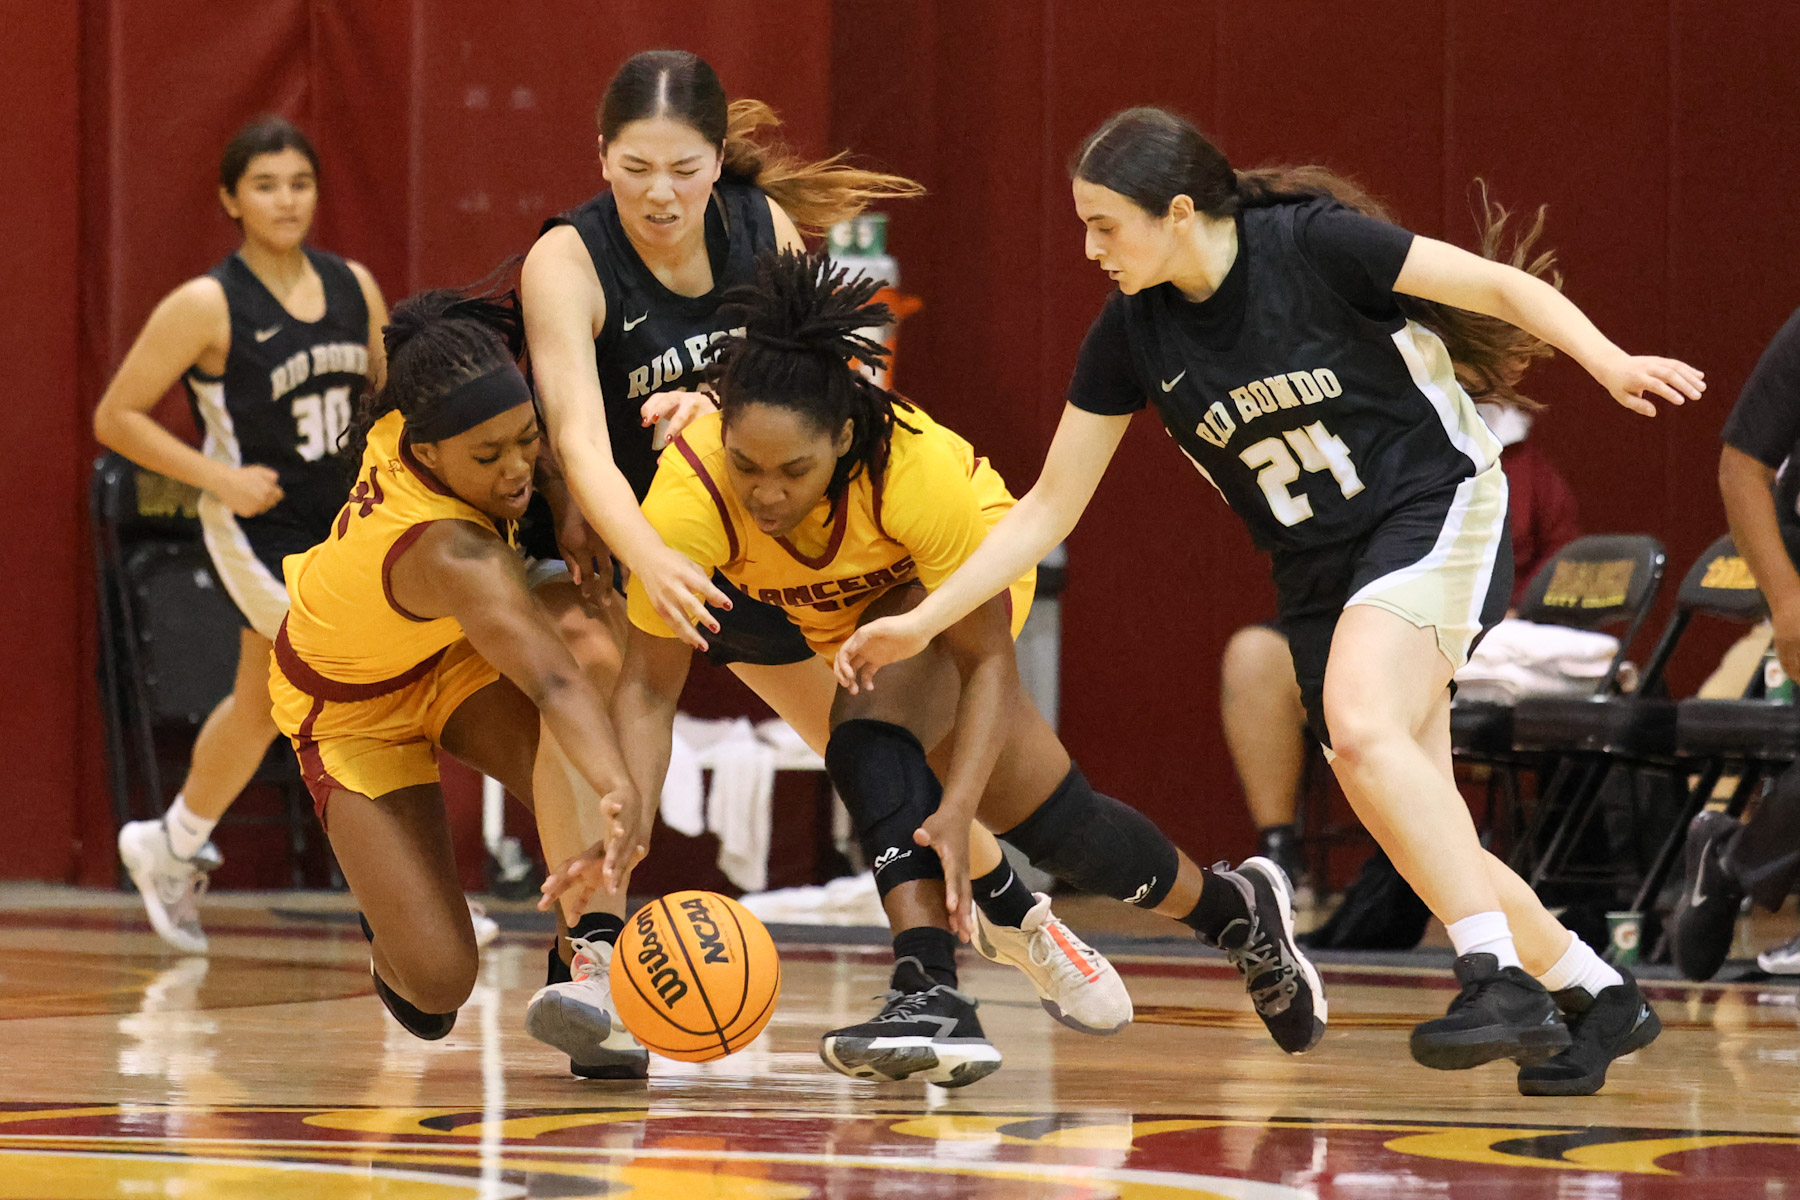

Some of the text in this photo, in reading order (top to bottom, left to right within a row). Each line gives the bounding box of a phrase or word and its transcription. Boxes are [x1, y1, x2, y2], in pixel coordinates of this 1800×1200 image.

[627, 346, 683, 399] RIO
[291, 383, 352, 462] 30
[1195, 400, 1237, 449] RIO
[1238, 419, 1366, 528] 24
[636, 906, 688, 1010] Wilson
[680, 898, 730, 965] NCAA
